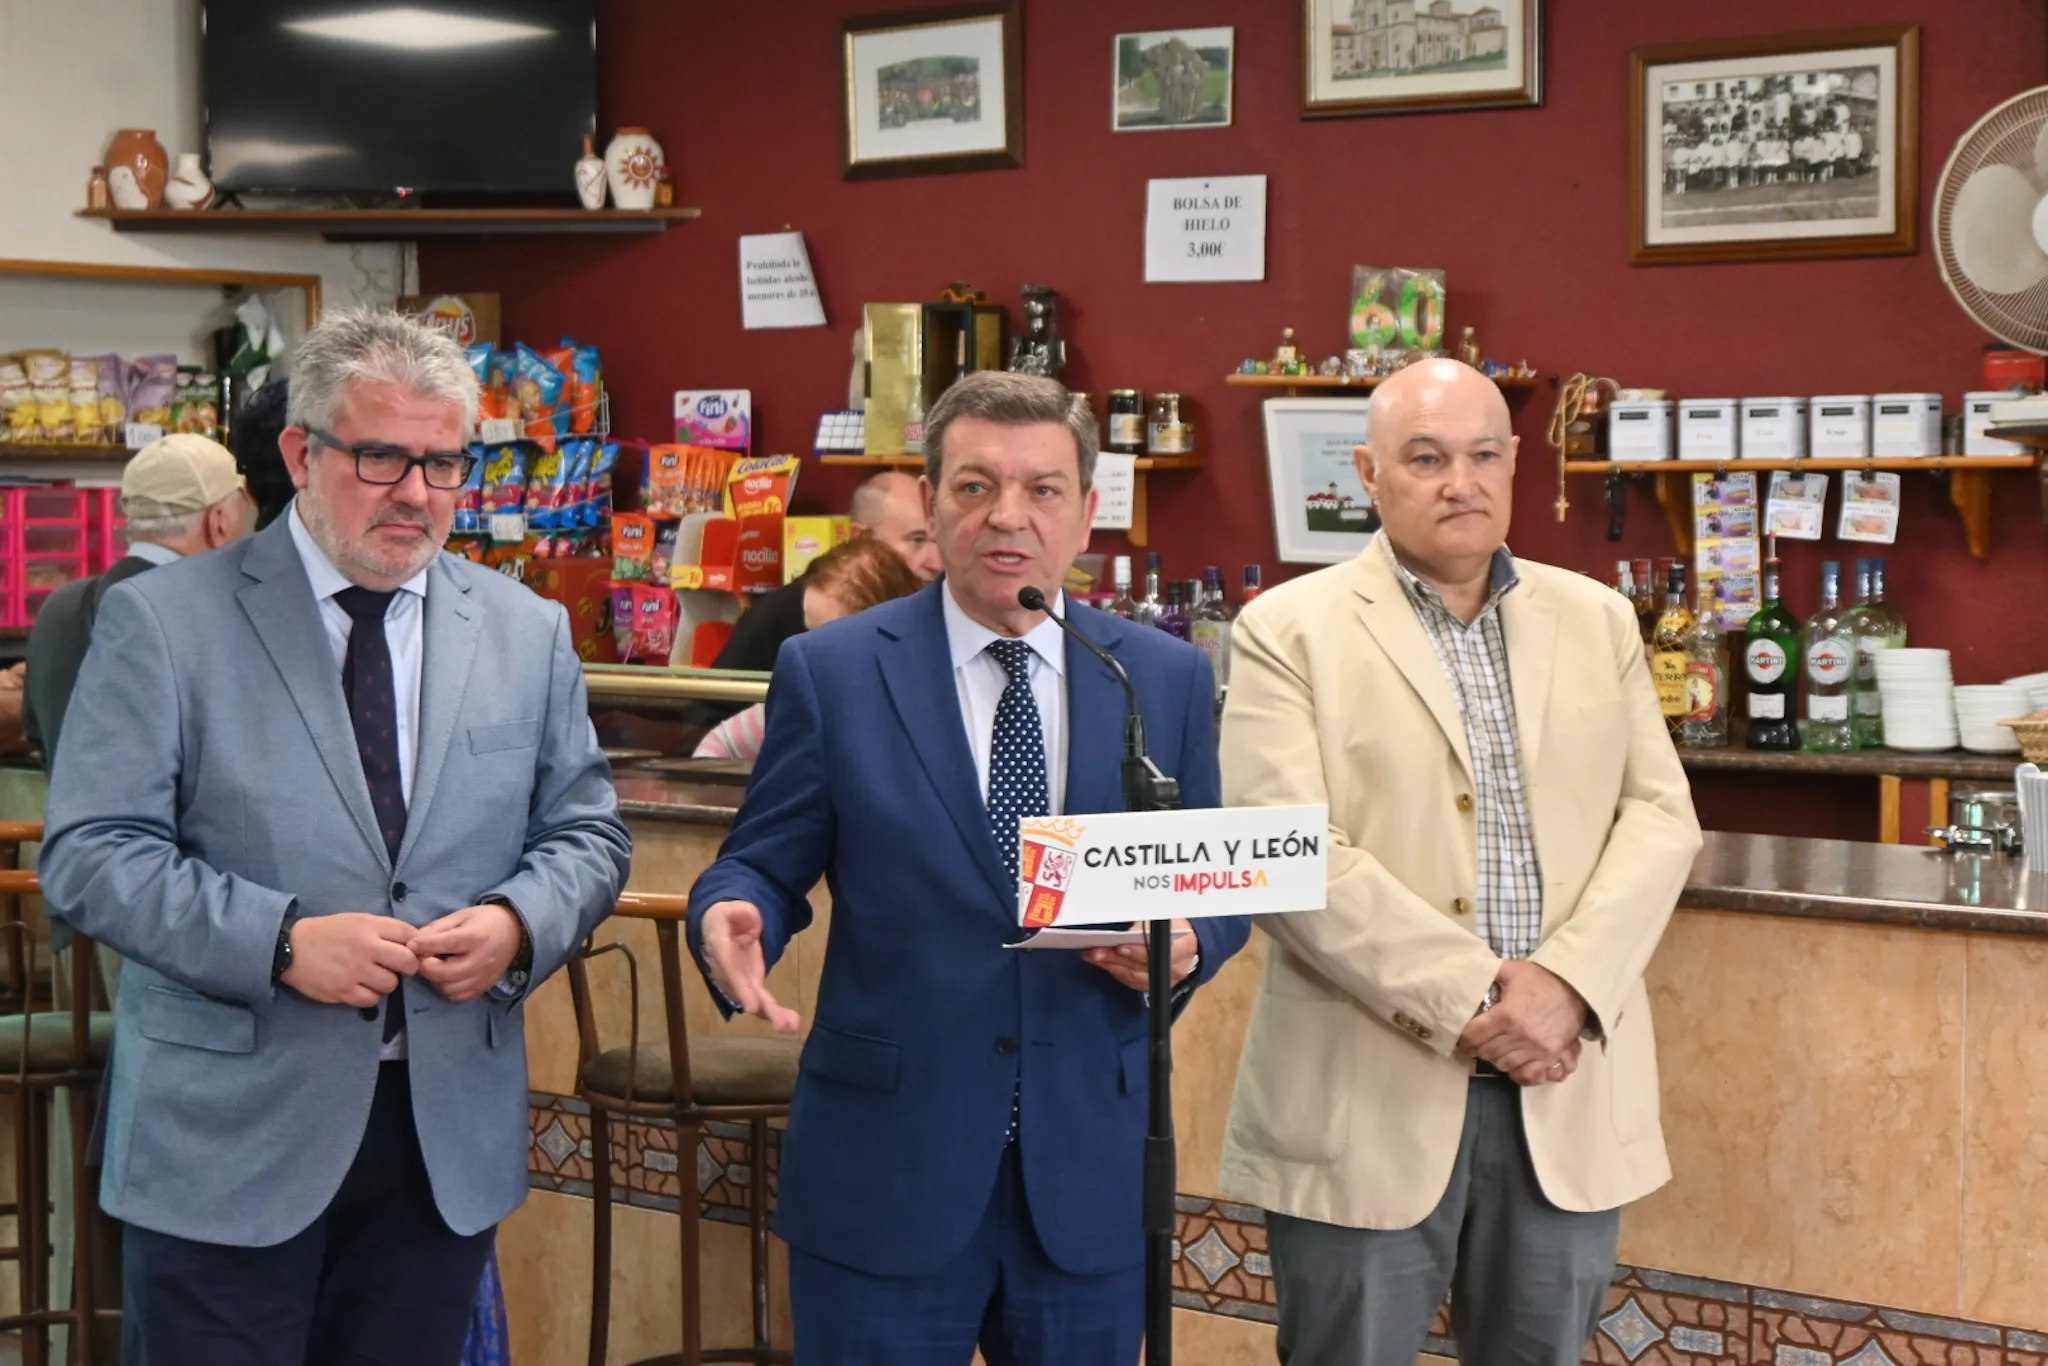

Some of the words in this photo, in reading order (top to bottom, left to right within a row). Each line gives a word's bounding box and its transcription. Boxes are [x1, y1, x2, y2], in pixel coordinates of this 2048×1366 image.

[1173, 195, 1220, 210] BOLSA
[1223, 195, 1242, 209] DE
[1184, 217, 1231, 231] HIELO
[1187, 241, 1225, 259] 3,00€
[747, 259, 790, 269] Prohibida
[747, 291, 785, 301] menores
[786, 288, 797, 298] de
[737, 455, 789, 475] ColaCao
[743, 547, 779, 564] nocilla
[1749, 655, 1784, 666] MARTINI
[1810, 656, 1847, 667] MARTINI
[1084, 842, 1211, 869] CASTILLA
[1224, 839, 1242, 866] Y
[1252, 829, 1319, 860] LEÓN
[1134, 874, 1171, 891] NOS
[1174, 868, 1269, 896] IMPULSA
